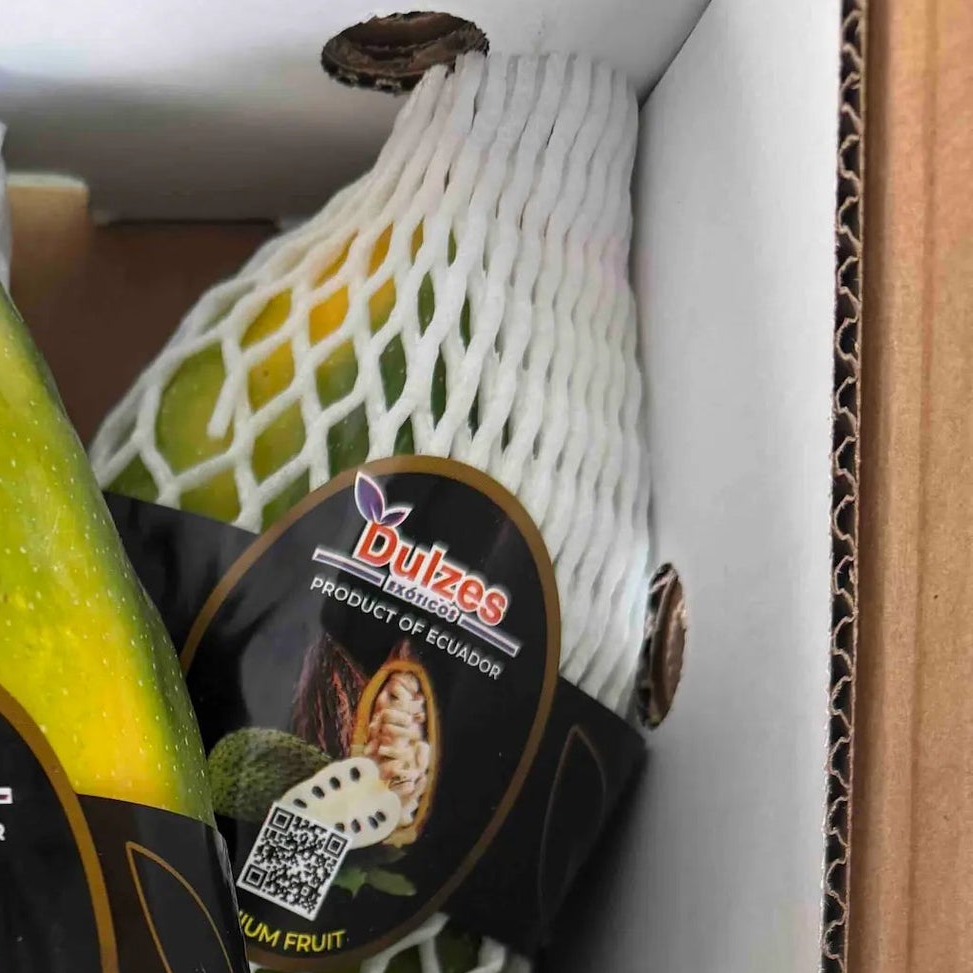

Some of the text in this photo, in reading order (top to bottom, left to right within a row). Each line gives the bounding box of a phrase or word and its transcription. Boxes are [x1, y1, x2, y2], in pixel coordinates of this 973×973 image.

[353, 521, 507, 625] Dulzes
[387, 580, 459, 622] EXÓTICOS
[310, 577, 502, 681] PRODUCT OF ECUADOR
[283, 929, 346, 952] FRUIT
